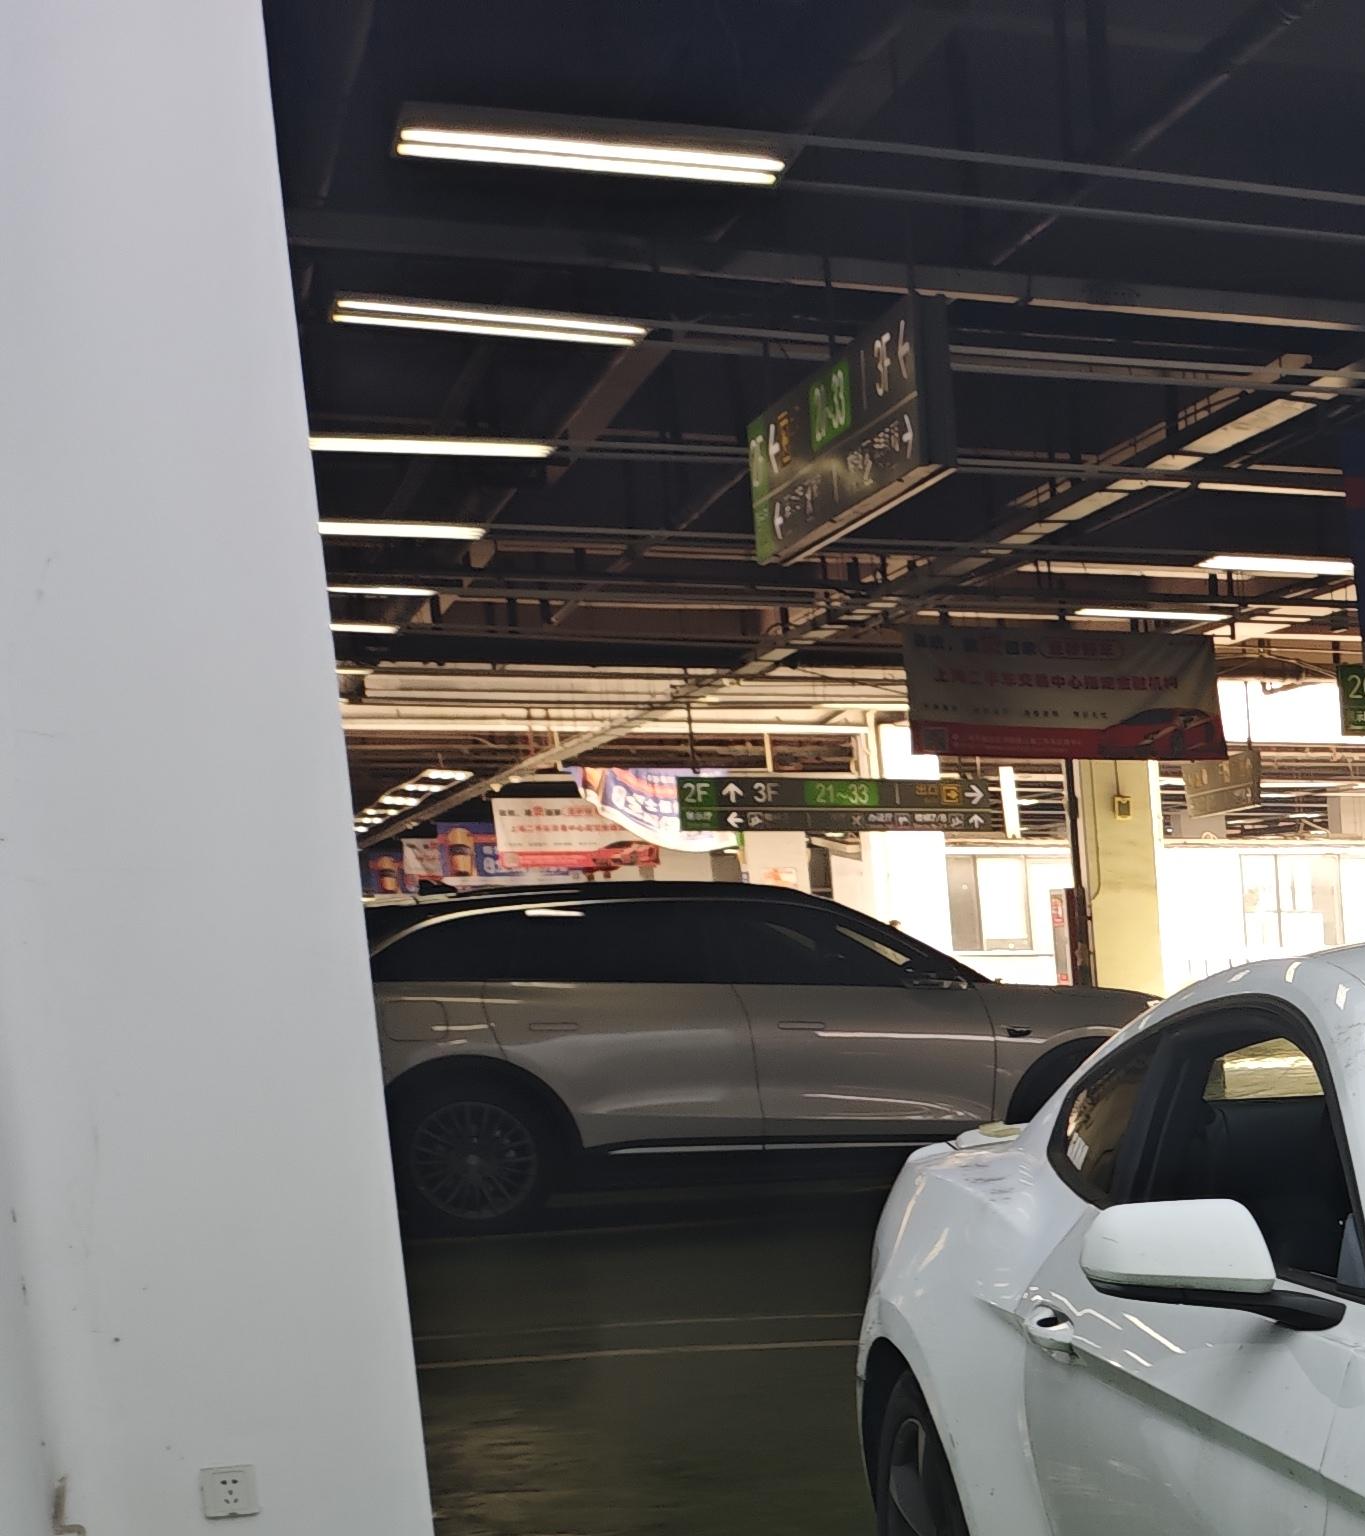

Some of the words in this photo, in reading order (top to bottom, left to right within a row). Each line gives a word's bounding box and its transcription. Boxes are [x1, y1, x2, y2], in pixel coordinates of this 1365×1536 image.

[682, 782, 711, 804] 2F
[752, 782, 779, 803] 3F
[815, 784, 870, 805] 21~33
